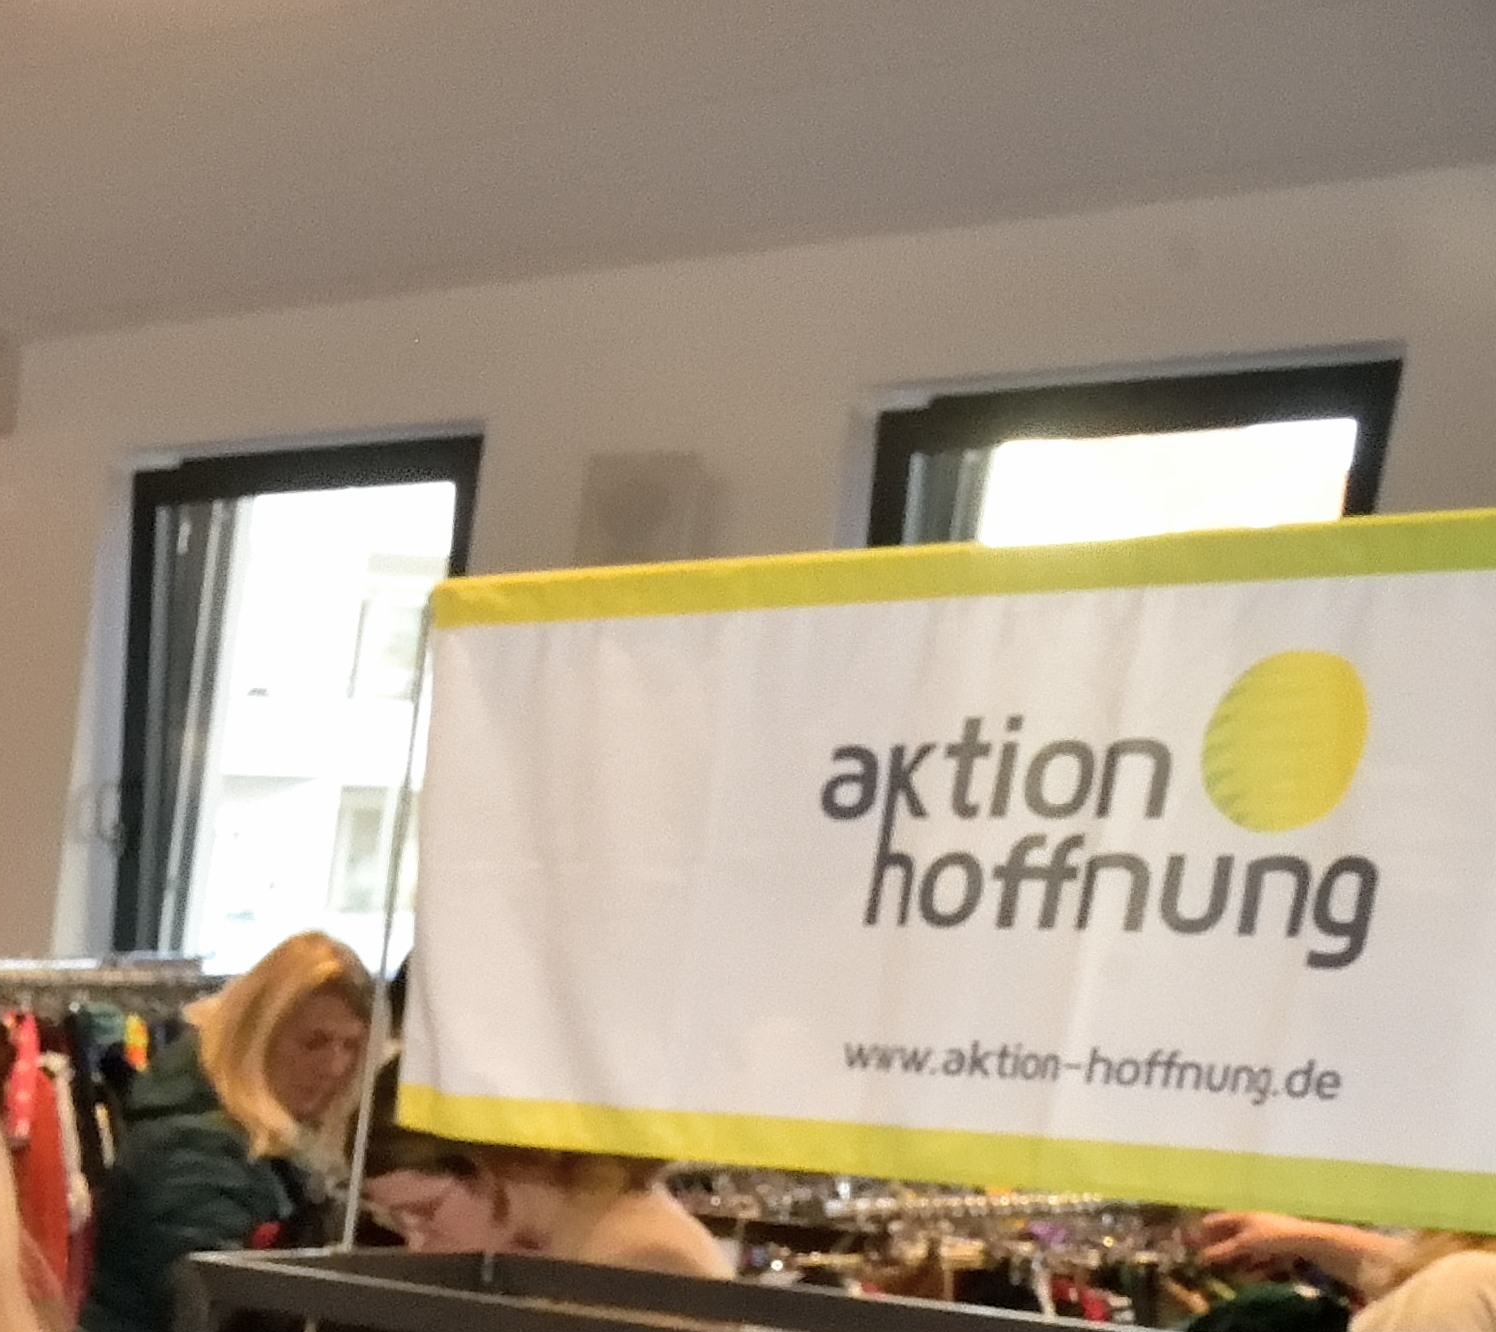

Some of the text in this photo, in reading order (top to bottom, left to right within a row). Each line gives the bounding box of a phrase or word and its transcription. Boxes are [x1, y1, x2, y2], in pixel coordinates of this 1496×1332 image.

[820, 715, 1173, 823] aktion
[863, 822, 1380, 968] hoffnung
[843, 1039, 1343, 1105] www.aktion-hoffnung.de
